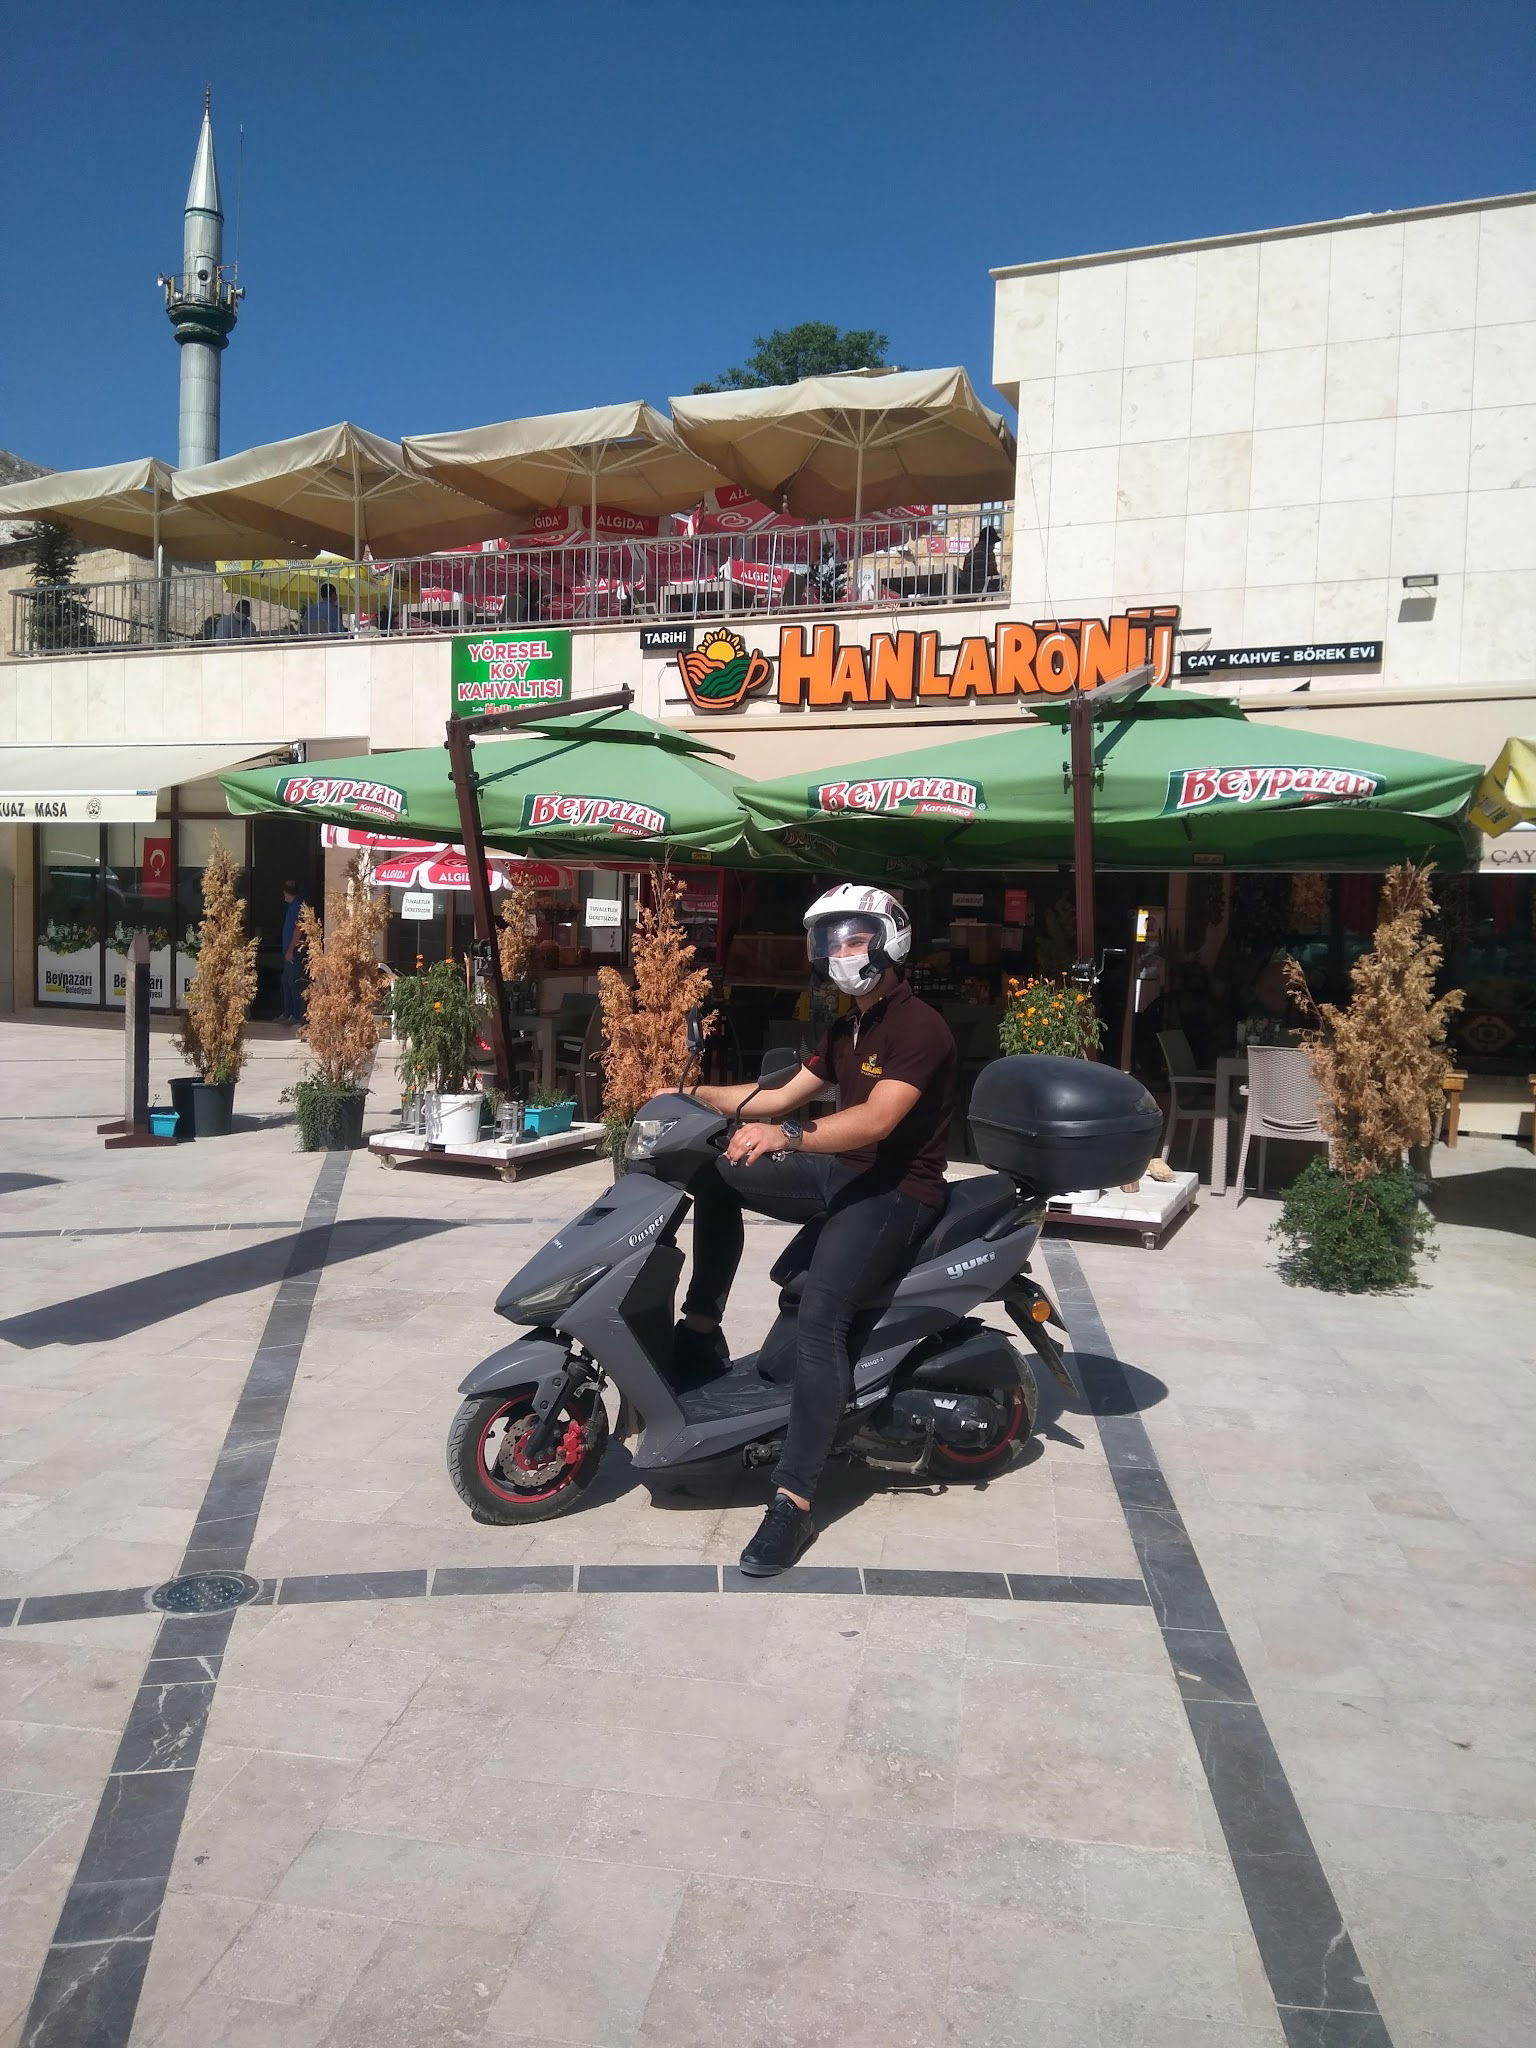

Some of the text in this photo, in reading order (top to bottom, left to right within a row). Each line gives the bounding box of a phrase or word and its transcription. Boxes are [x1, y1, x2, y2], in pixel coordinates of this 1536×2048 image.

[644, 631, 687, 645] TARiHi
[468, 640, 552, 662] YÖRESEL
[778, 605, 1180, 705] HANLARÖNÜ
[1188, 655, 1217, 668] ÇAY
[1229, 652, 1281, 665] KAHVE
[1294, 646, 1346, 662] BÖREK
[1350, 645, 1375, 658] EVi
[490, 659, 530, 680] KÖY
[458, 679, 562, 701] KAHVALTISI
[284, 777, 403, 812] Beypazarı
[819, 777, 977, 812] Beypazarı
[1176, 768, 1378, 809] Beypazarı
[35, 802, 67, 817] MASA
[358, 803, 397, 820] Karakoca
[529, 795, 666, 834] Beypazarı
[921, 803, 971, 817] Karakoca
[45, 971, 92, 987] Beypazarı
[628, 1214, 665, 1247] Casper
